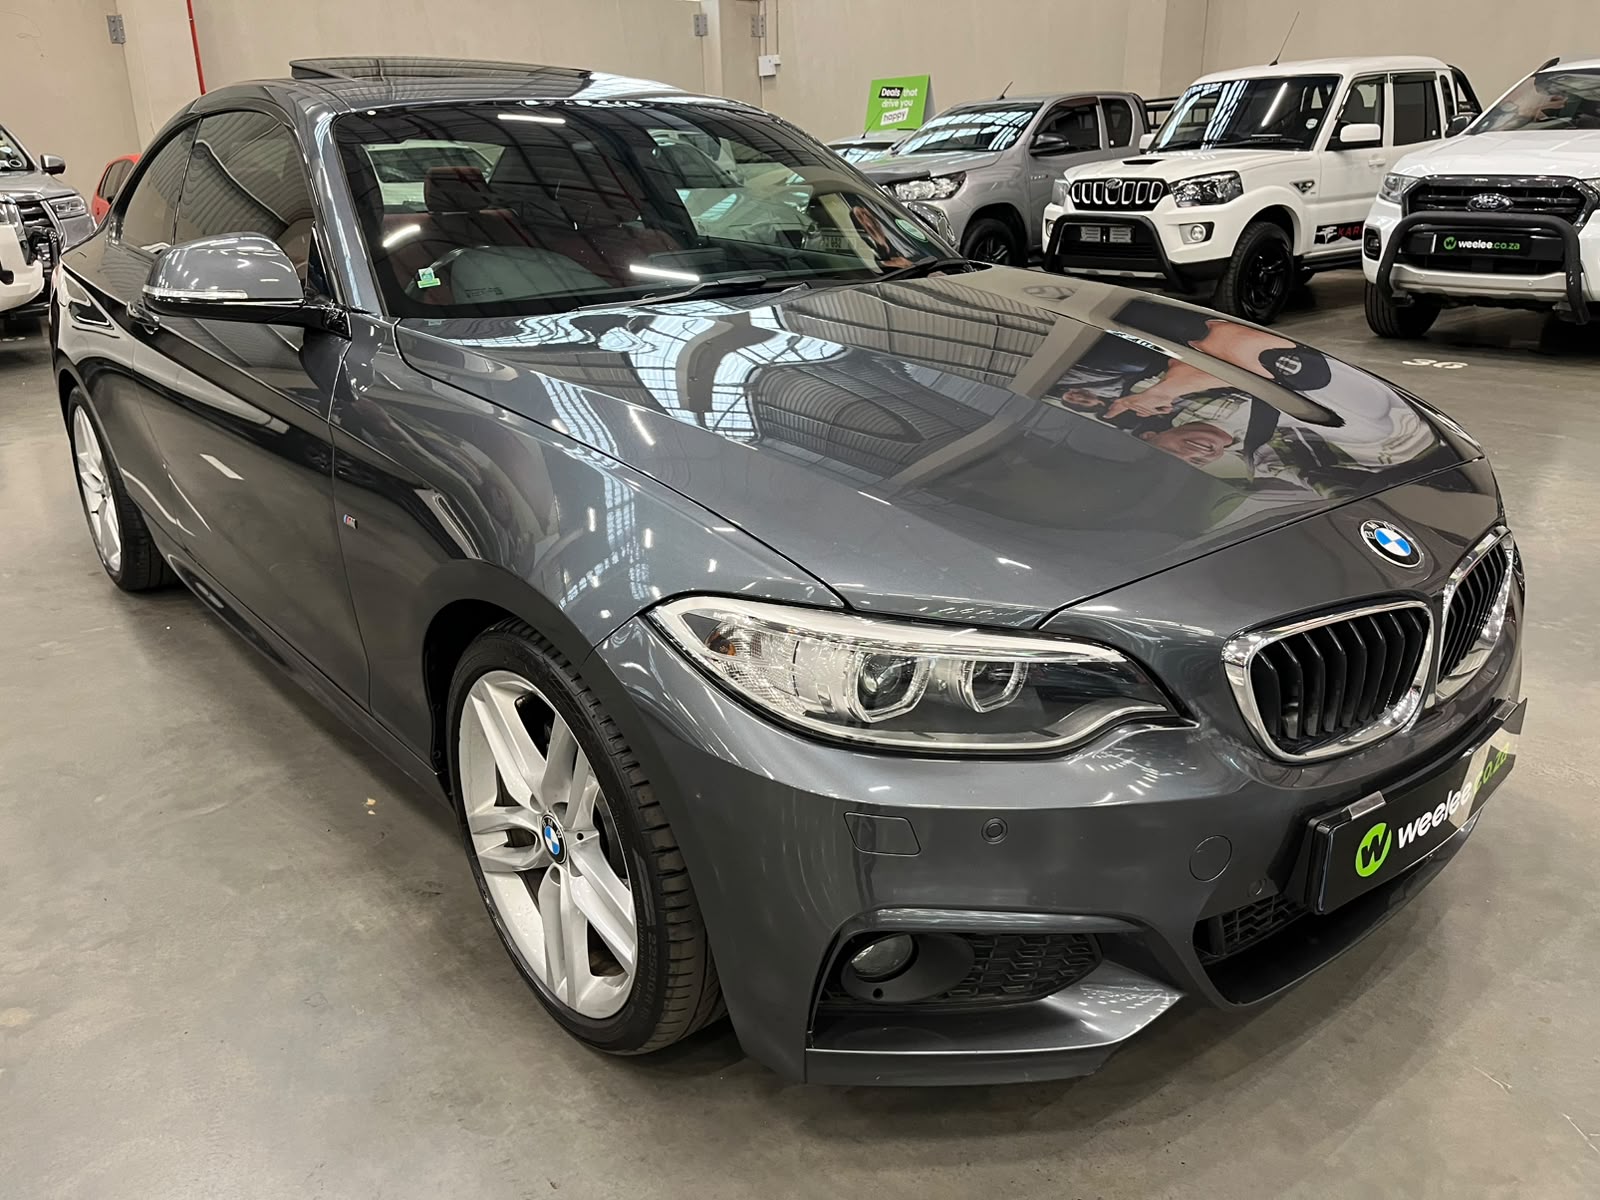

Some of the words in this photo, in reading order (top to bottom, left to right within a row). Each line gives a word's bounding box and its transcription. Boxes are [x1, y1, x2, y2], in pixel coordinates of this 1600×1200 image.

[881, 88, 901, 97] Deals
[903, 88, 918, 97] that
[881, 99, 899, 108] drive
[900, 99, 914, 109] you
[883, 110, 907, 122] happy
[1338, 226, 1362, 238] KAR
[1458, 240, 1520, 250] weelee.co.za
